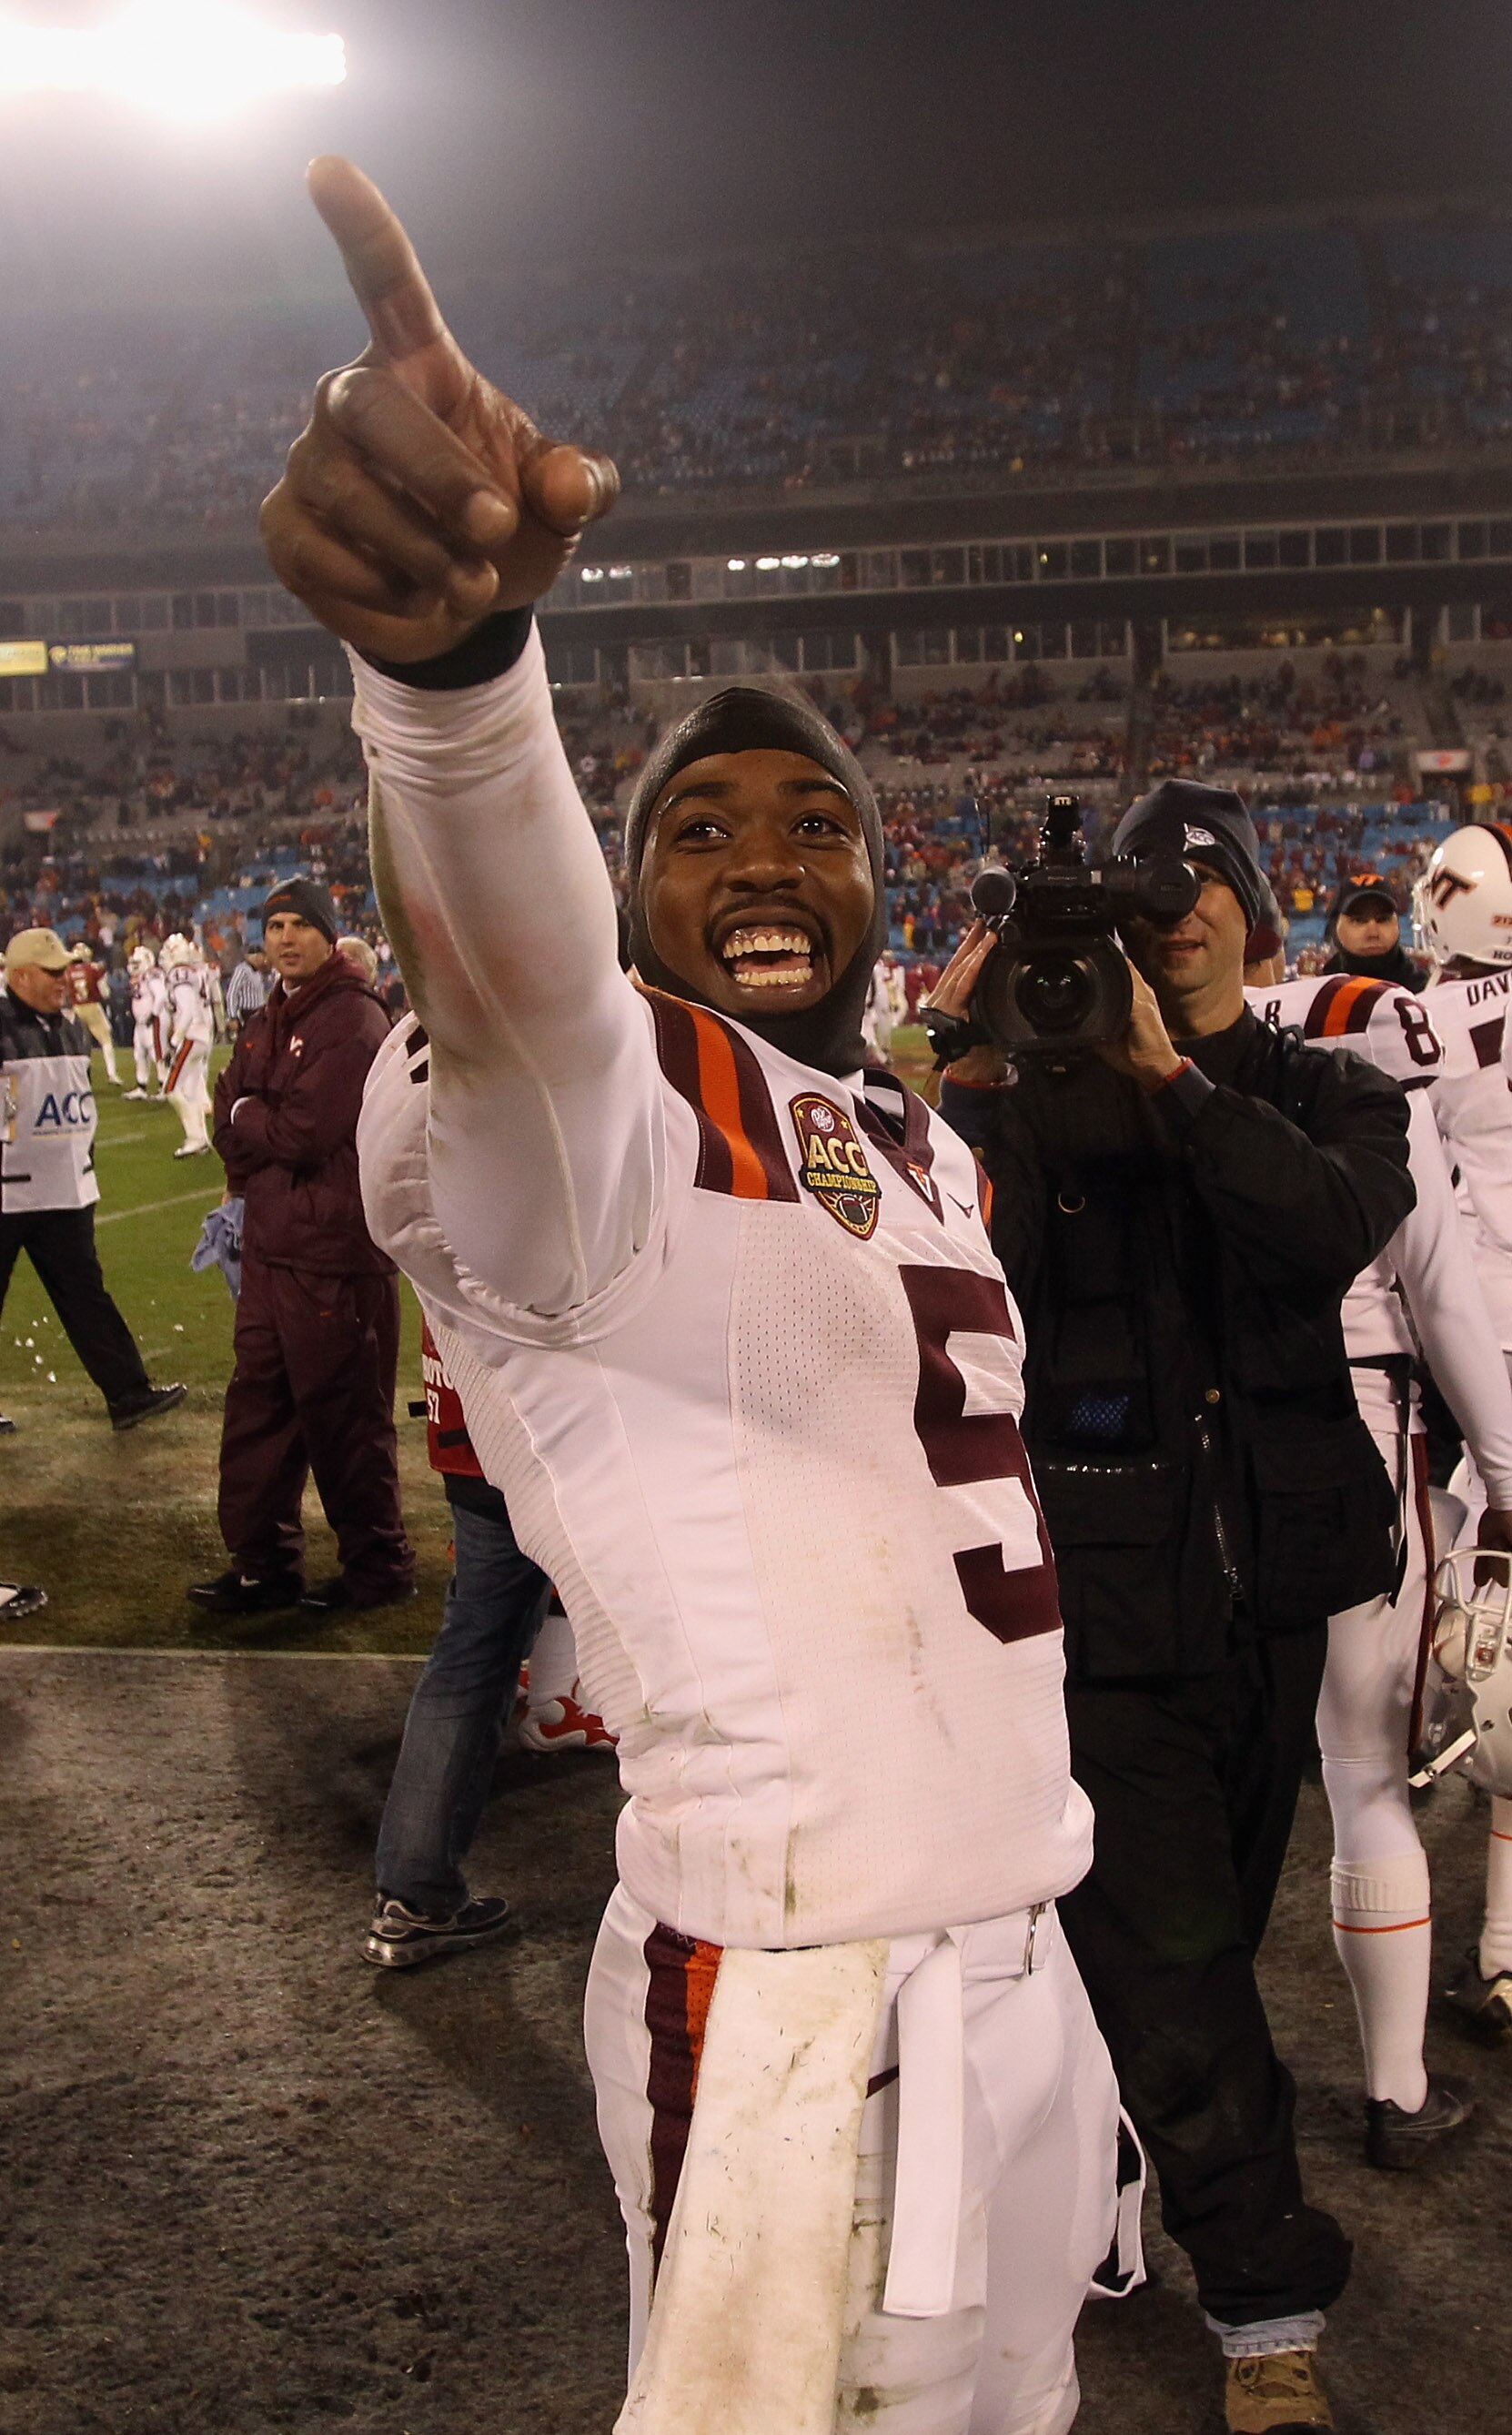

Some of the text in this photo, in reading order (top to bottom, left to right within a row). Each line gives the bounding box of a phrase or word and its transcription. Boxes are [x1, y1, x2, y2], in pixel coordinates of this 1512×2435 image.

[1467, 972, 1512, 1006] DAV
[1394, 997, 1441, 1066] 8
[35, 1091, 94, 1127] ACC
[808, 1135, 869, 1177] ACC
[806, 1171, 877, 1194] CHAMPIONSHIP
[898, 1264, 1063, 1644] 5
